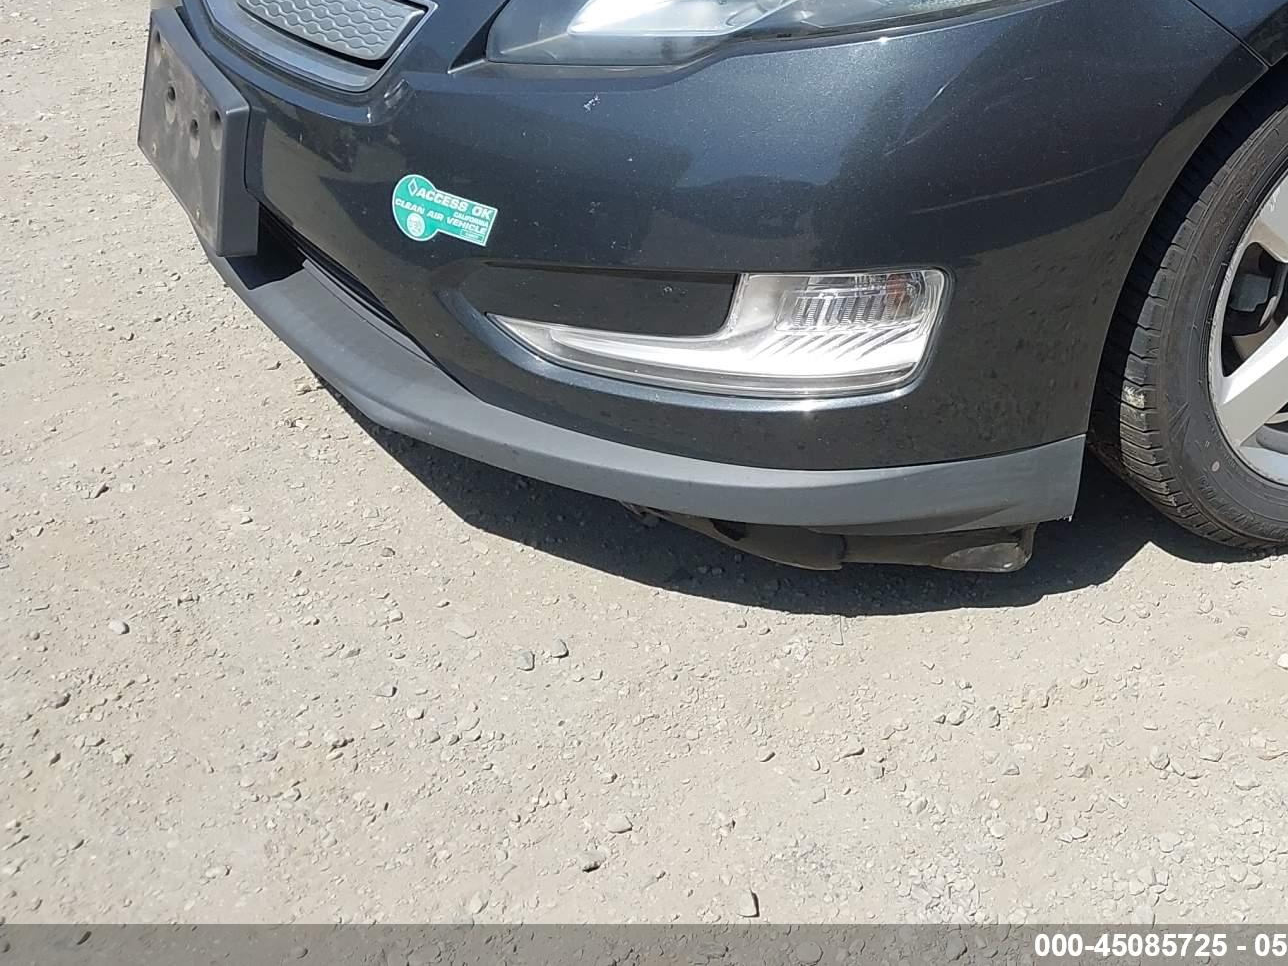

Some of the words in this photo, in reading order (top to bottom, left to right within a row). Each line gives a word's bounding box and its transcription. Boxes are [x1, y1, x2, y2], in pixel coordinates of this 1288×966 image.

[395, 198, 425, 214] CLEAN
[426, 210, 444, 221] AIR
[447, 216, 487, 235] VEHICLE
[416, 187, 469, 212] ACCESS
[471, 205, 494, 220] OK
